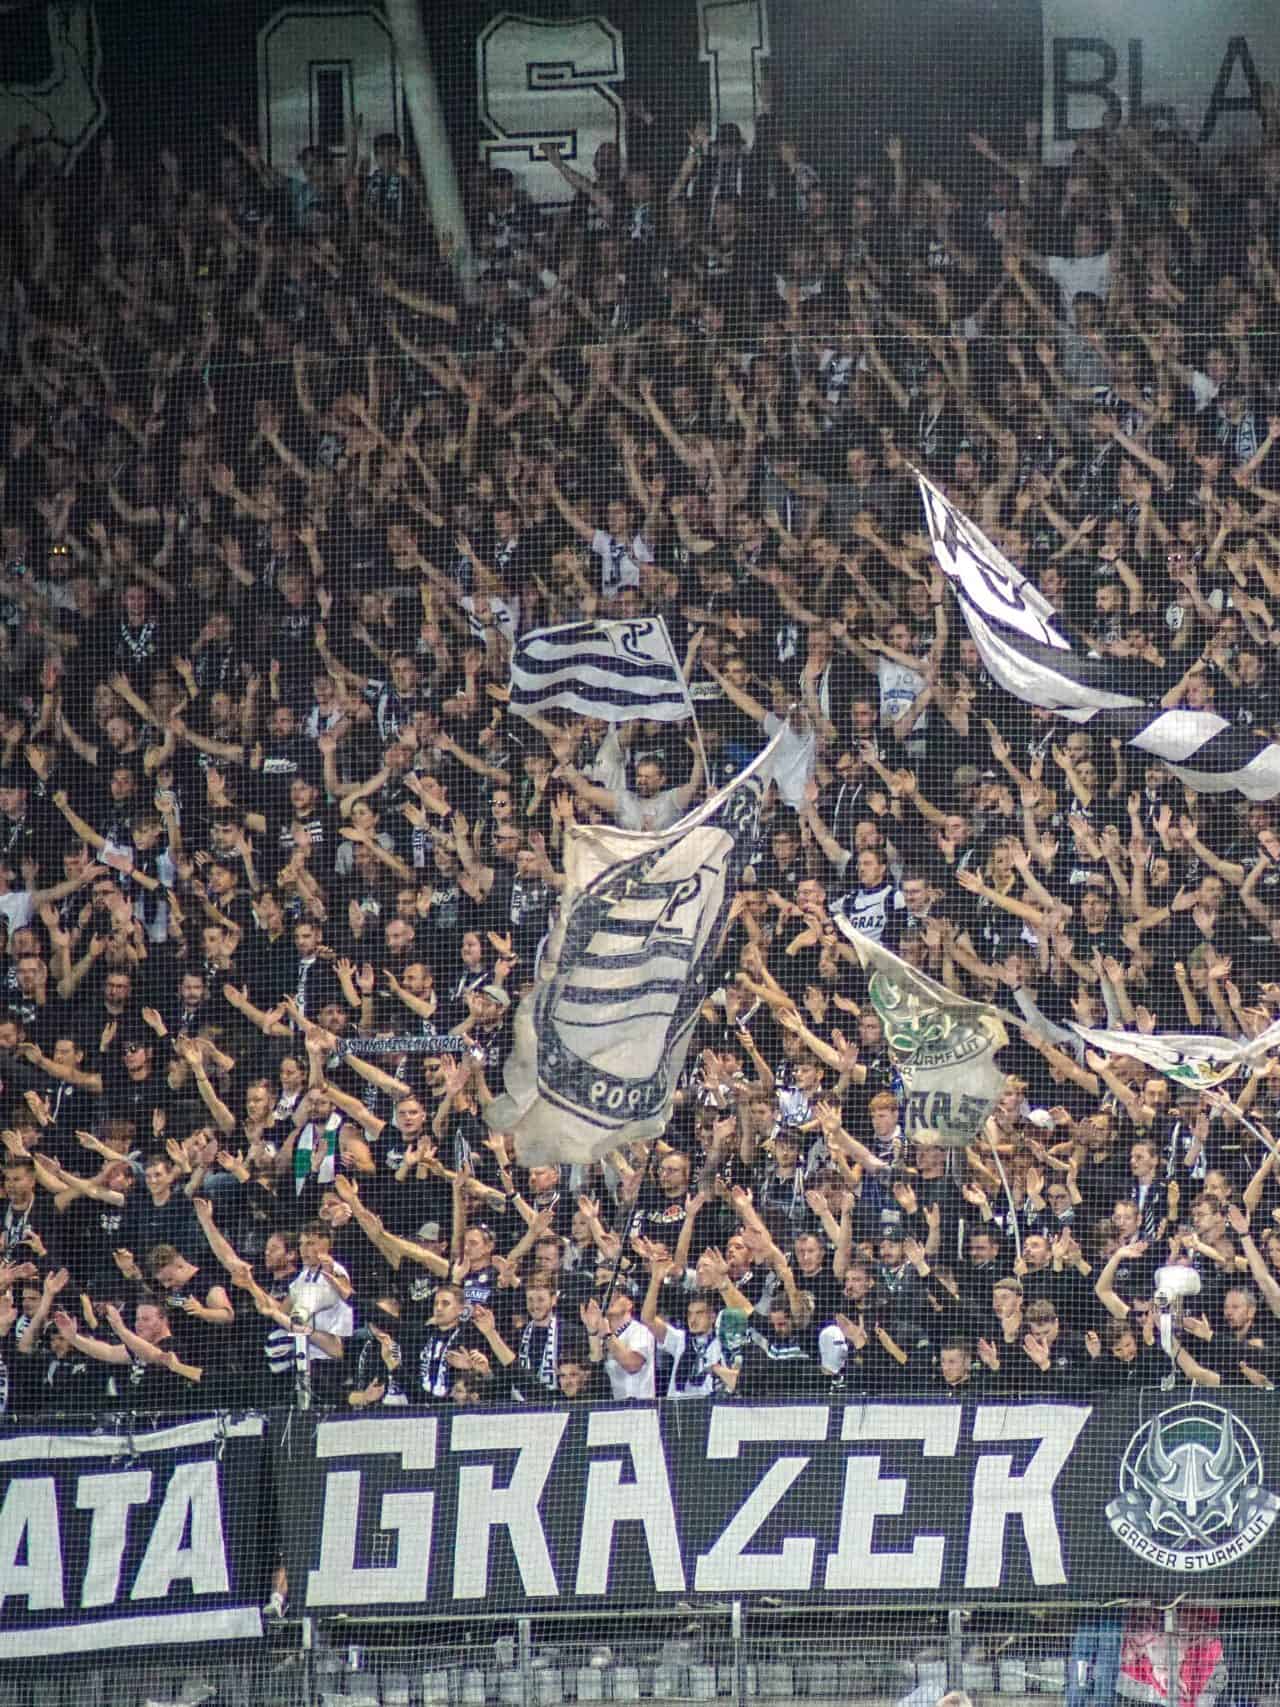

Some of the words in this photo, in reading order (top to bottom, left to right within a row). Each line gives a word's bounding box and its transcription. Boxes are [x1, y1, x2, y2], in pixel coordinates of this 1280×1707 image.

[850, 915, 884, 929] GRAZ
[306, 1403, 1094, 1607] GRAZER
[1117, 1521, 1178, 1568] GRAZER
[1184, 1515, 1270, 1570] STURMFLUT
